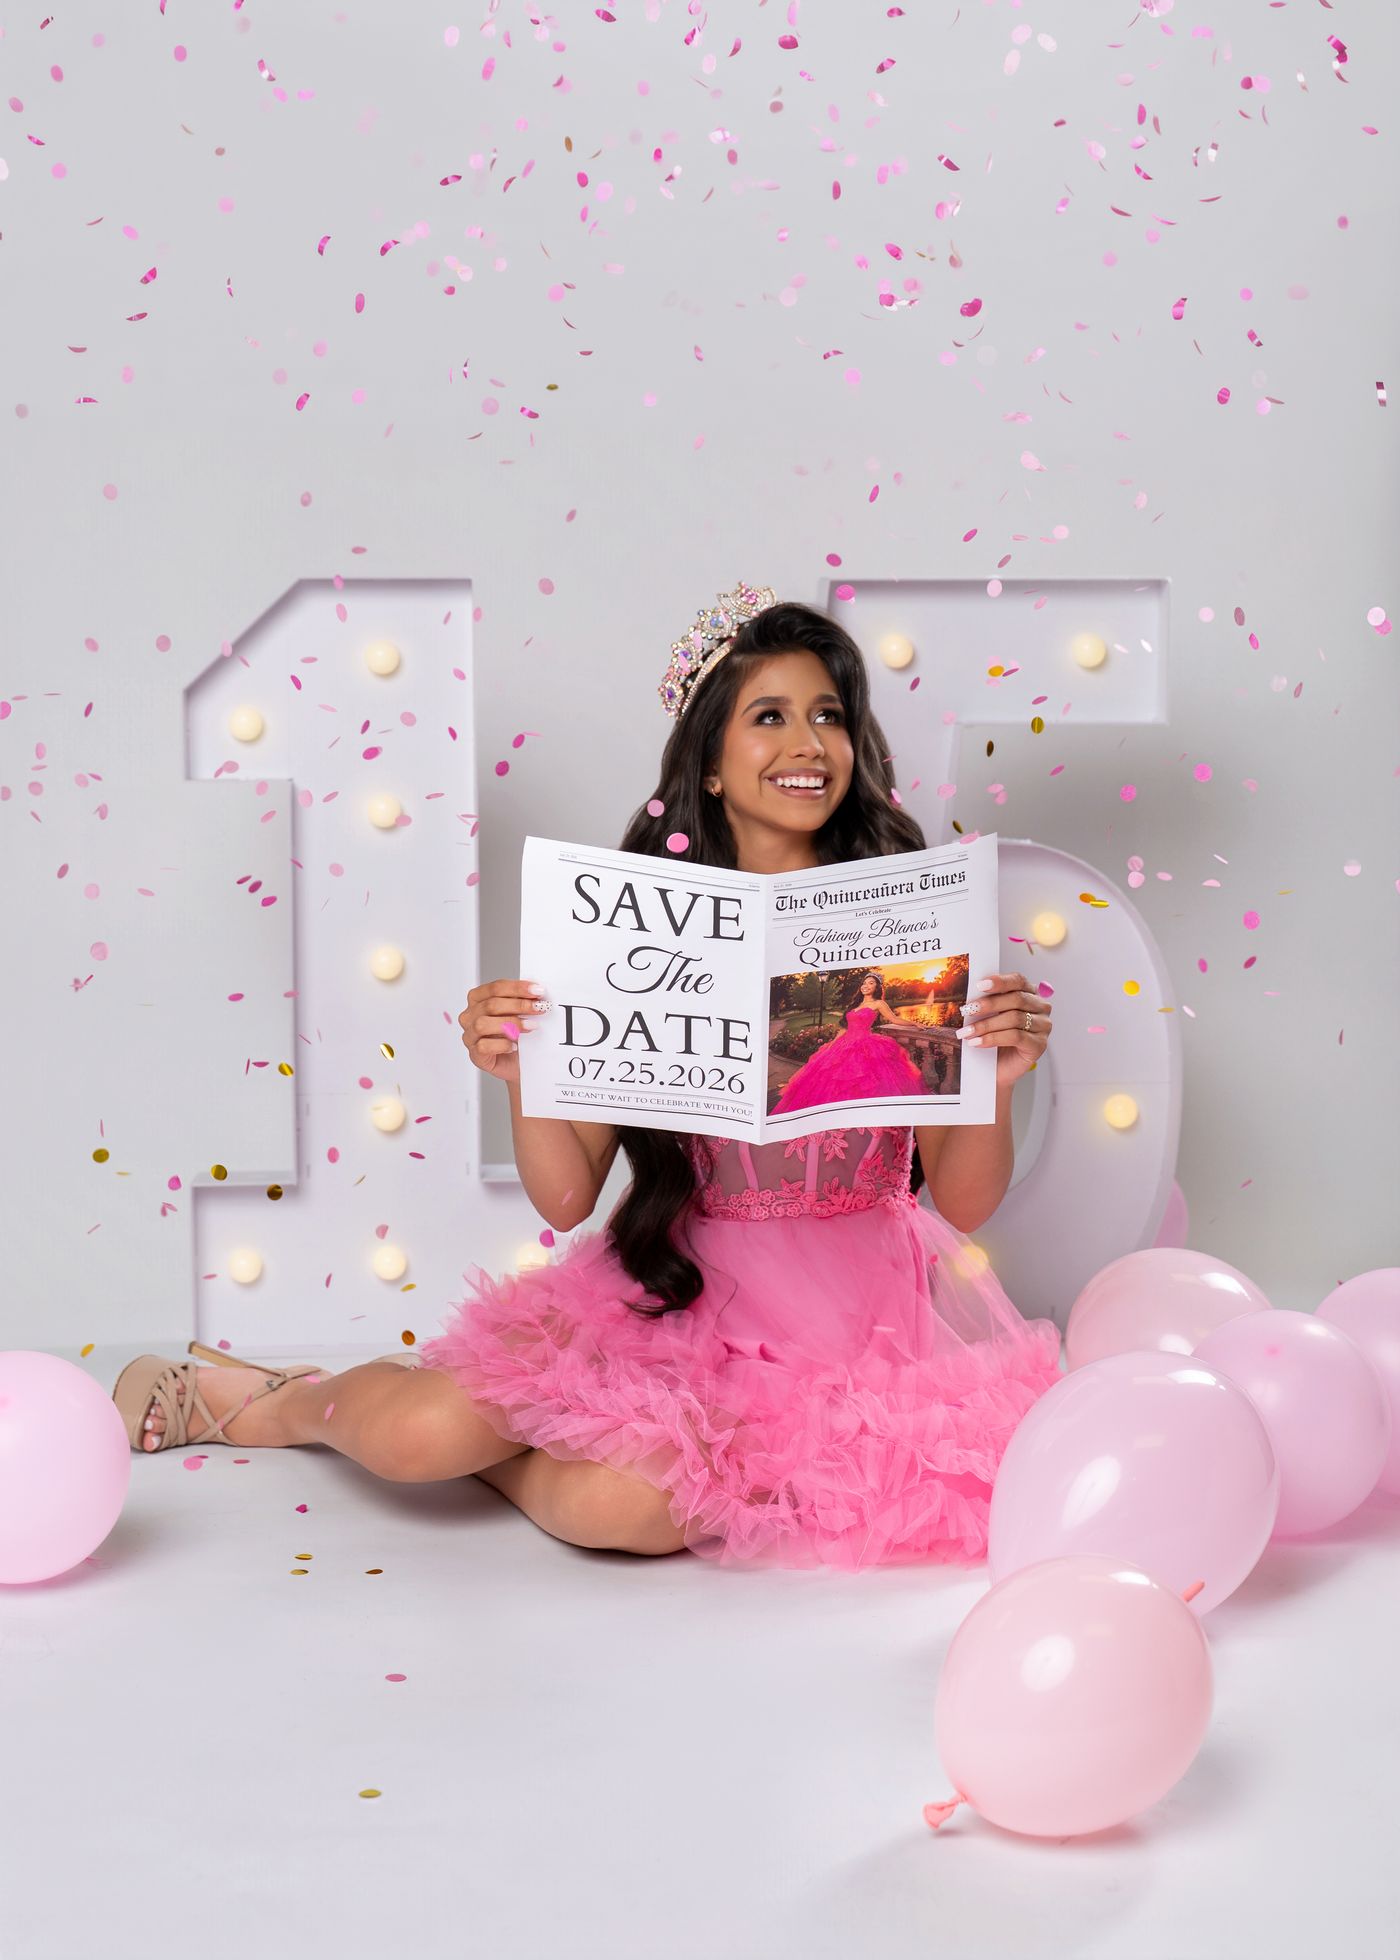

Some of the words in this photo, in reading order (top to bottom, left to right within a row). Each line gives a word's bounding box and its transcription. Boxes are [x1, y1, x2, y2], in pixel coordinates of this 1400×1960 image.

[571, 873, 746, 942] SAVE
[775, 894, 808, 913] The
[813, 882, 915, 909] Quinceañera
[919, 870, 966, 891] Times
[793, 927, 863, 947] Tahiany
[868, 911, 939, 938] Blanco's
[855, 910, 868, 918] Let's
[868, 907, 892, 916] Celebrate
[606, 946, 715, 995] The
[799, 936, 942, 968] Quinceañera
[558, 1004, 754, 1063] DATE
[568, 1057, 745, 1095] 07.25.2026
[578, 1091, 606, 1100] CAN'T
[607, 1095, 633, 1103] WAIT
[650, 1098, 702, 1109] CELEBRATE
[703, 1102, 729, 1112] WITH
[730, 1106, 753, 1117] YOU!
